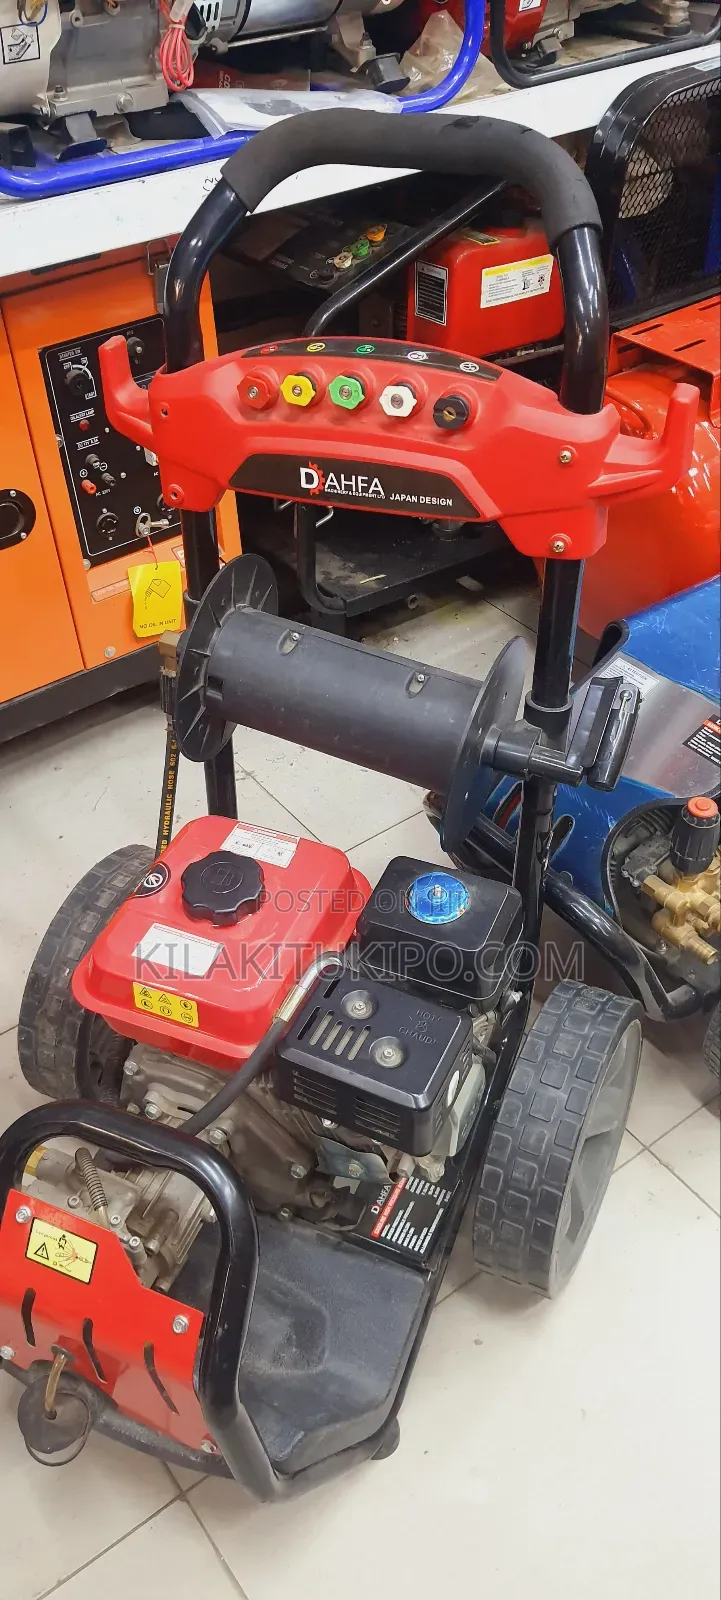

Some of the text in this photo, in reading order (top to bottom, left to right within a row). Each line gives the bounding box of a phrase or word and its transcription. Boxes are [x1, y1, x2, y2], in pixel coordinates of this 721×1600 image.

[389, 493, 453, 507] JAPAN DESIGN
[163, 794, 172, 835] HYDRAULIC
